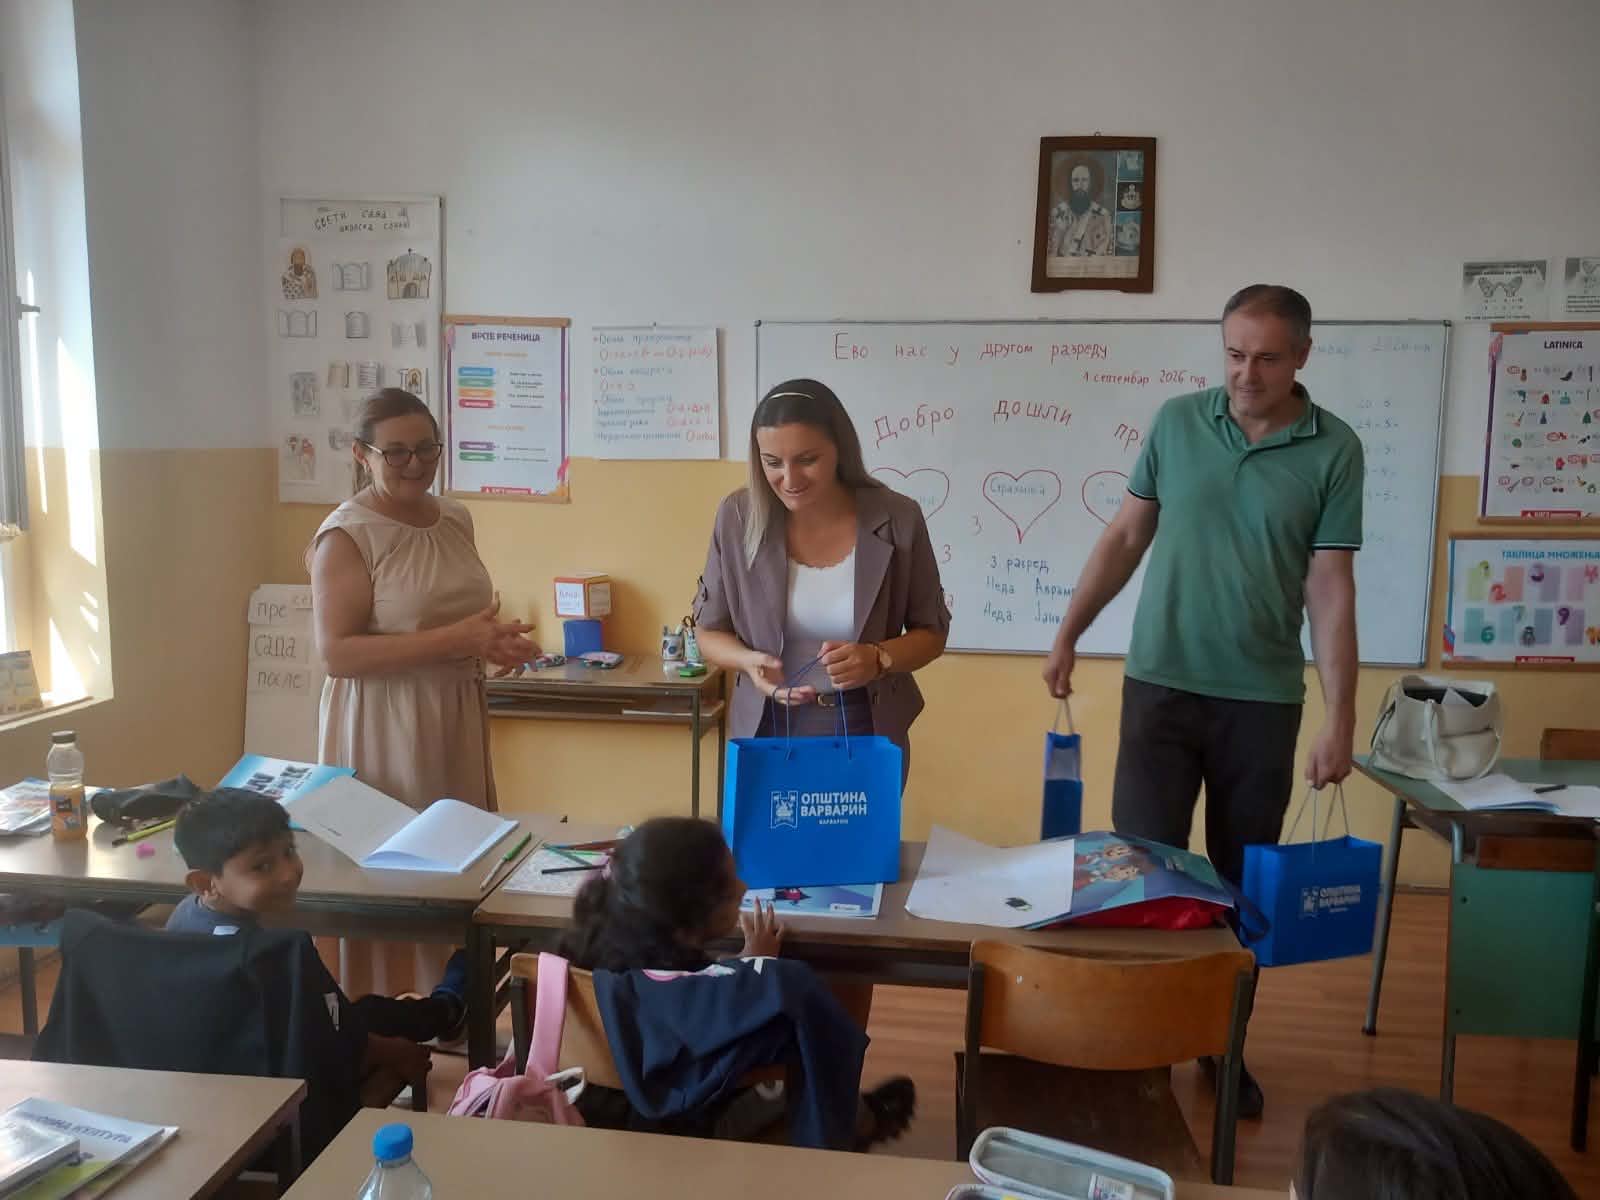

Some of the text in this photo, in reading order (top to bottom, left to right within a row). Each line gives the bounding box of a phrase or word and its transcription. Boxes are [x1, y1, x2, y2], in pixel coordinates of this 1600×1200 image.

[496, 332, 541, 343] РЕЧЕНИЦА
[1543, 340, 1583, 349] LATINICA
[834, 332, 1108, 365] Ево нас у другом разреду
[1159, 369, 1188, 383] 2026
[874, 404, 954, 448] Добро
[1490, 584, 1506, 602] 2
[1557, 607, 1571, 626] 9
[1481, 626, 1495, 643] 6
[801, 791, 868, 804] ОПШТИНА
[800, 804, 868, 817] ВАРВАРИН
